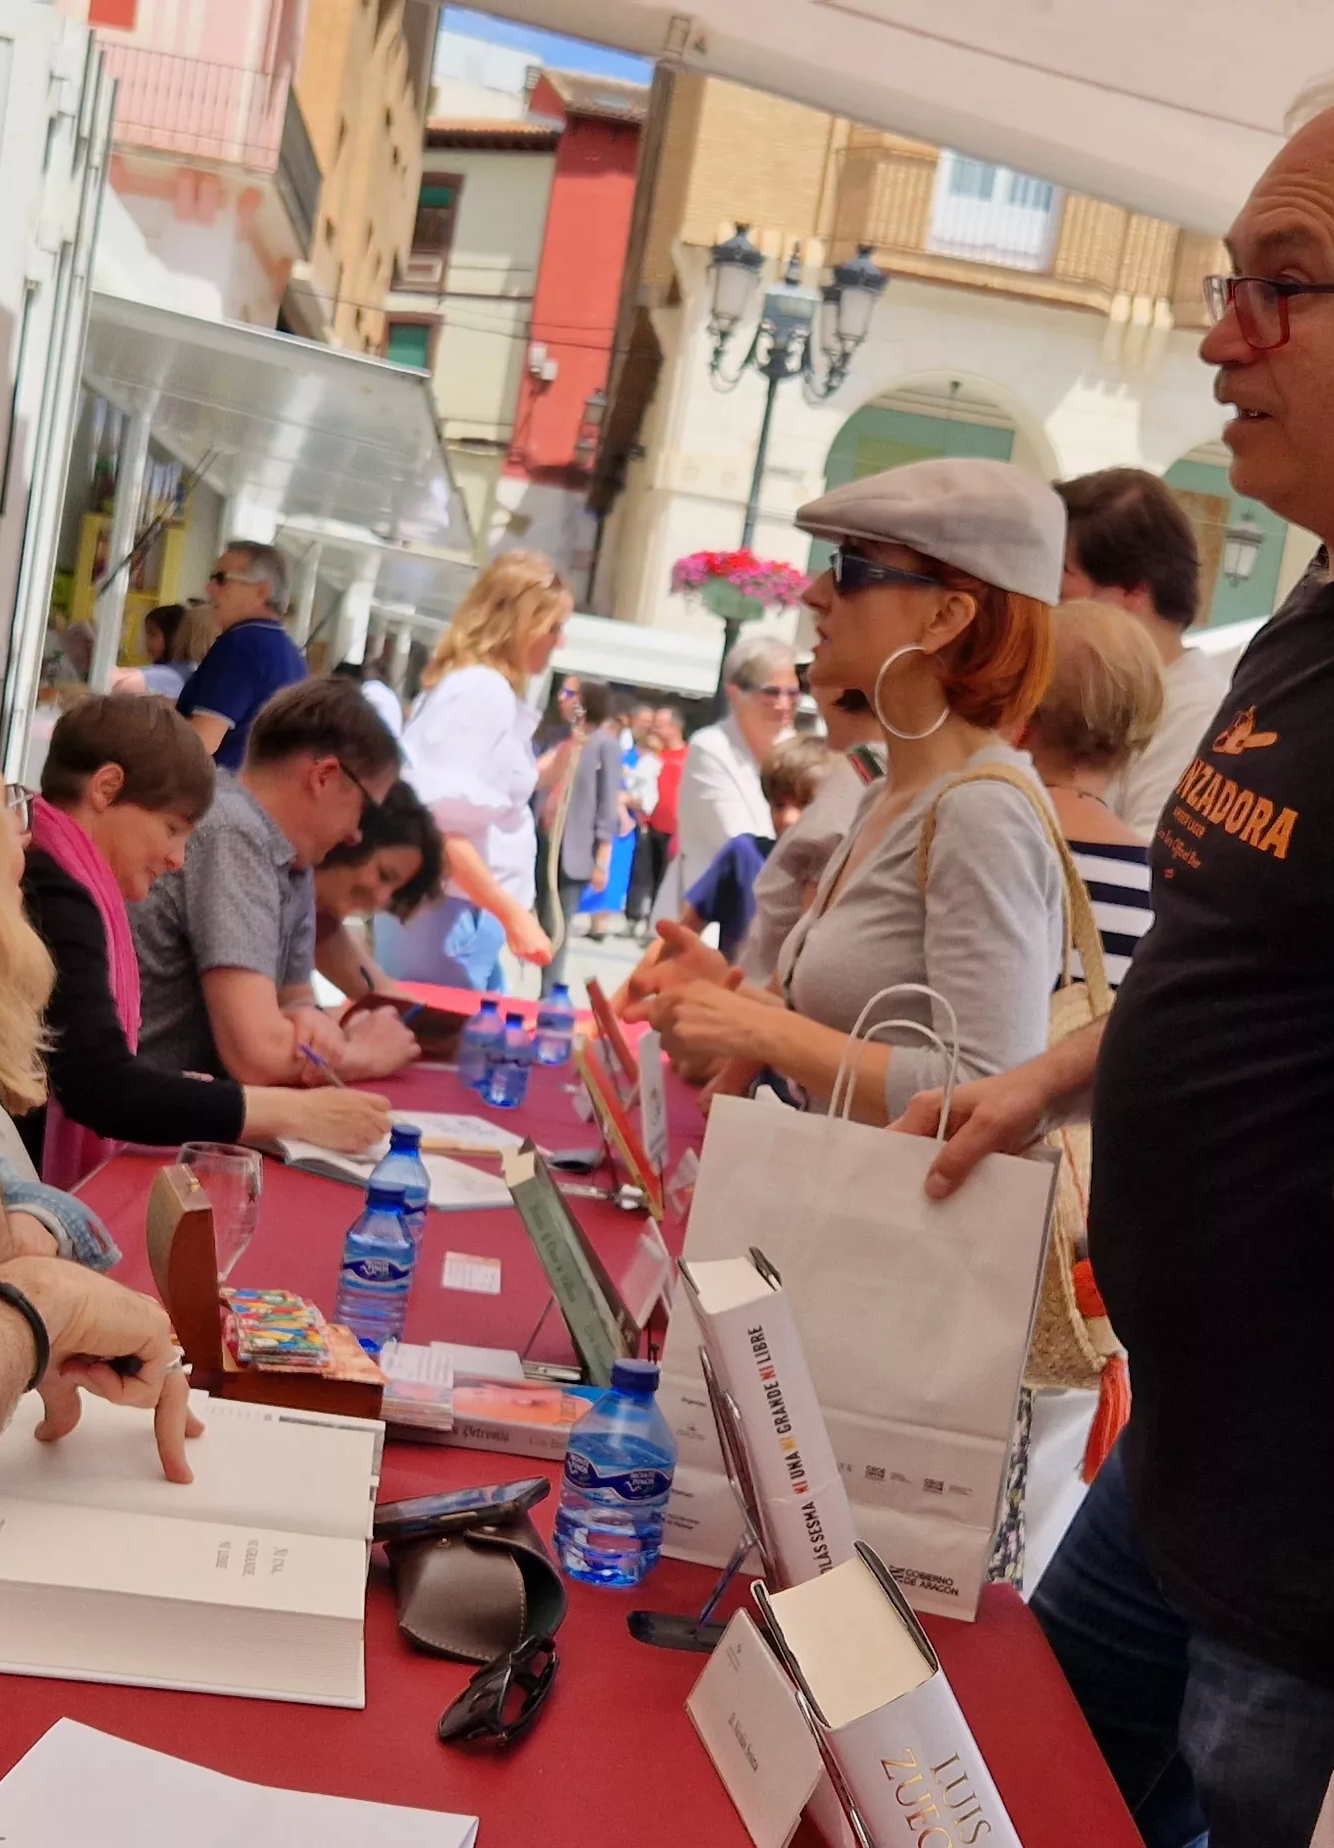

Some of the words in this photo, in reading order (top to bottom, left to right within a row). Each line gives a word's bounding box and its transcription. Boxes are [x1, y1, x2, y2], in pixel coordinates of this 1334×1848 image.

[1175, 756, 1299, 860] NZADORA
[748, 1325, 772, 1365] LIBRE
[758, 1365, 777, 1381] NI
[763, 1380, 792, 1434] GRANDE
[779, 1435, 798, 1451] NI
[784, 1451, 805, 1480] UNA
[792, 1480, 810, 1496] NI
[801, 1501, 825, 1544] SESMA
[903, 1577, 917, 1586] DE
[905, 1568, 954, 1586] GOBIERNO
[930, 1752, 992, 1845] LUIS
